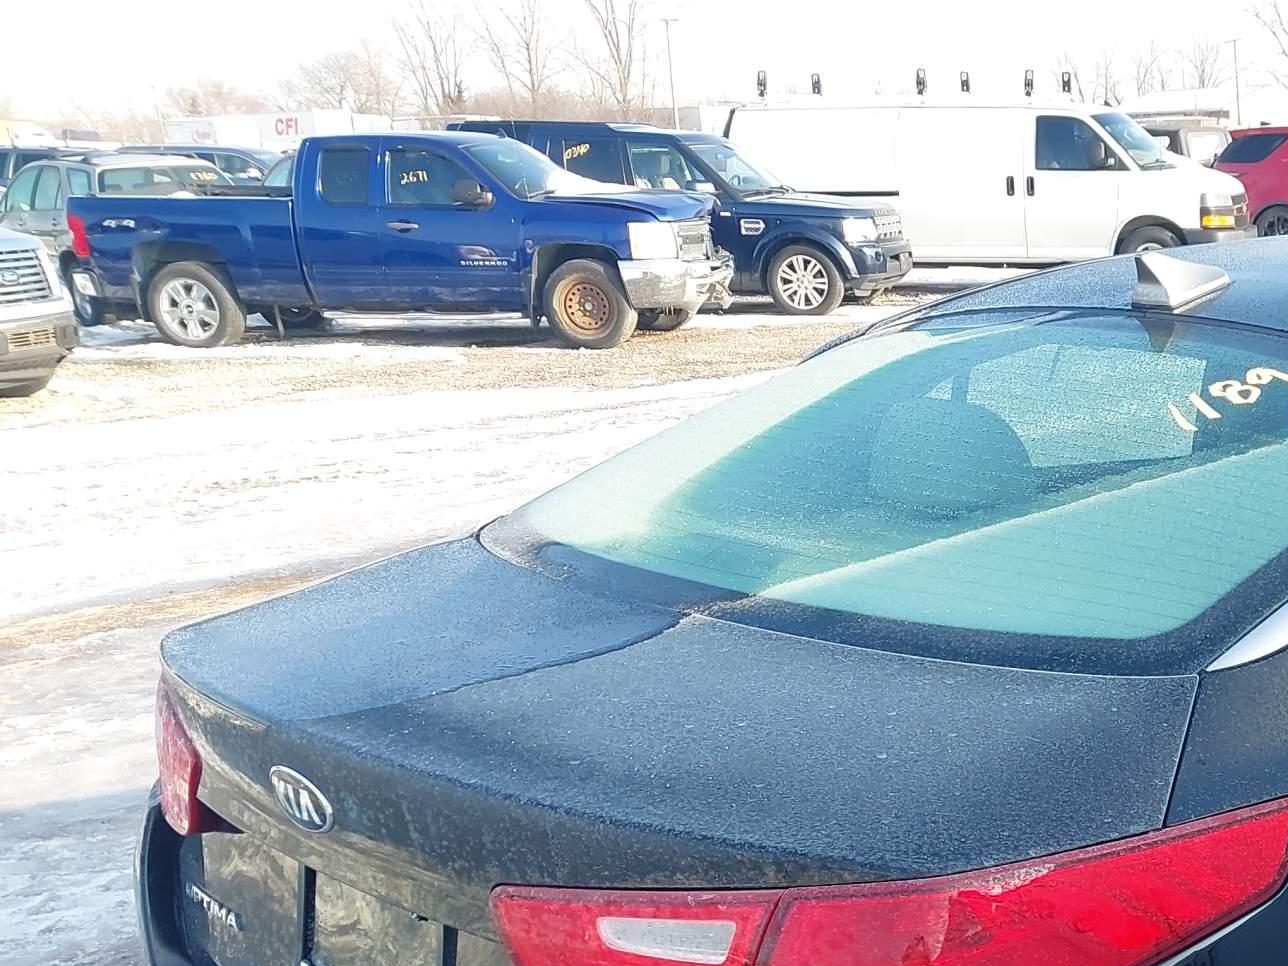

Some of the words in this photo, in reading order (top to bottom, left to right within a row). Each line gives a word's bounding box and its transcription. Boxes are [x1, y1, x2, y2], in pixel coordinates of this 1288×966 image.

[274, 118, 299, 136] CFI
[400, 170, 428, 185] 2671
[271, 775, 323, 825] KIA
